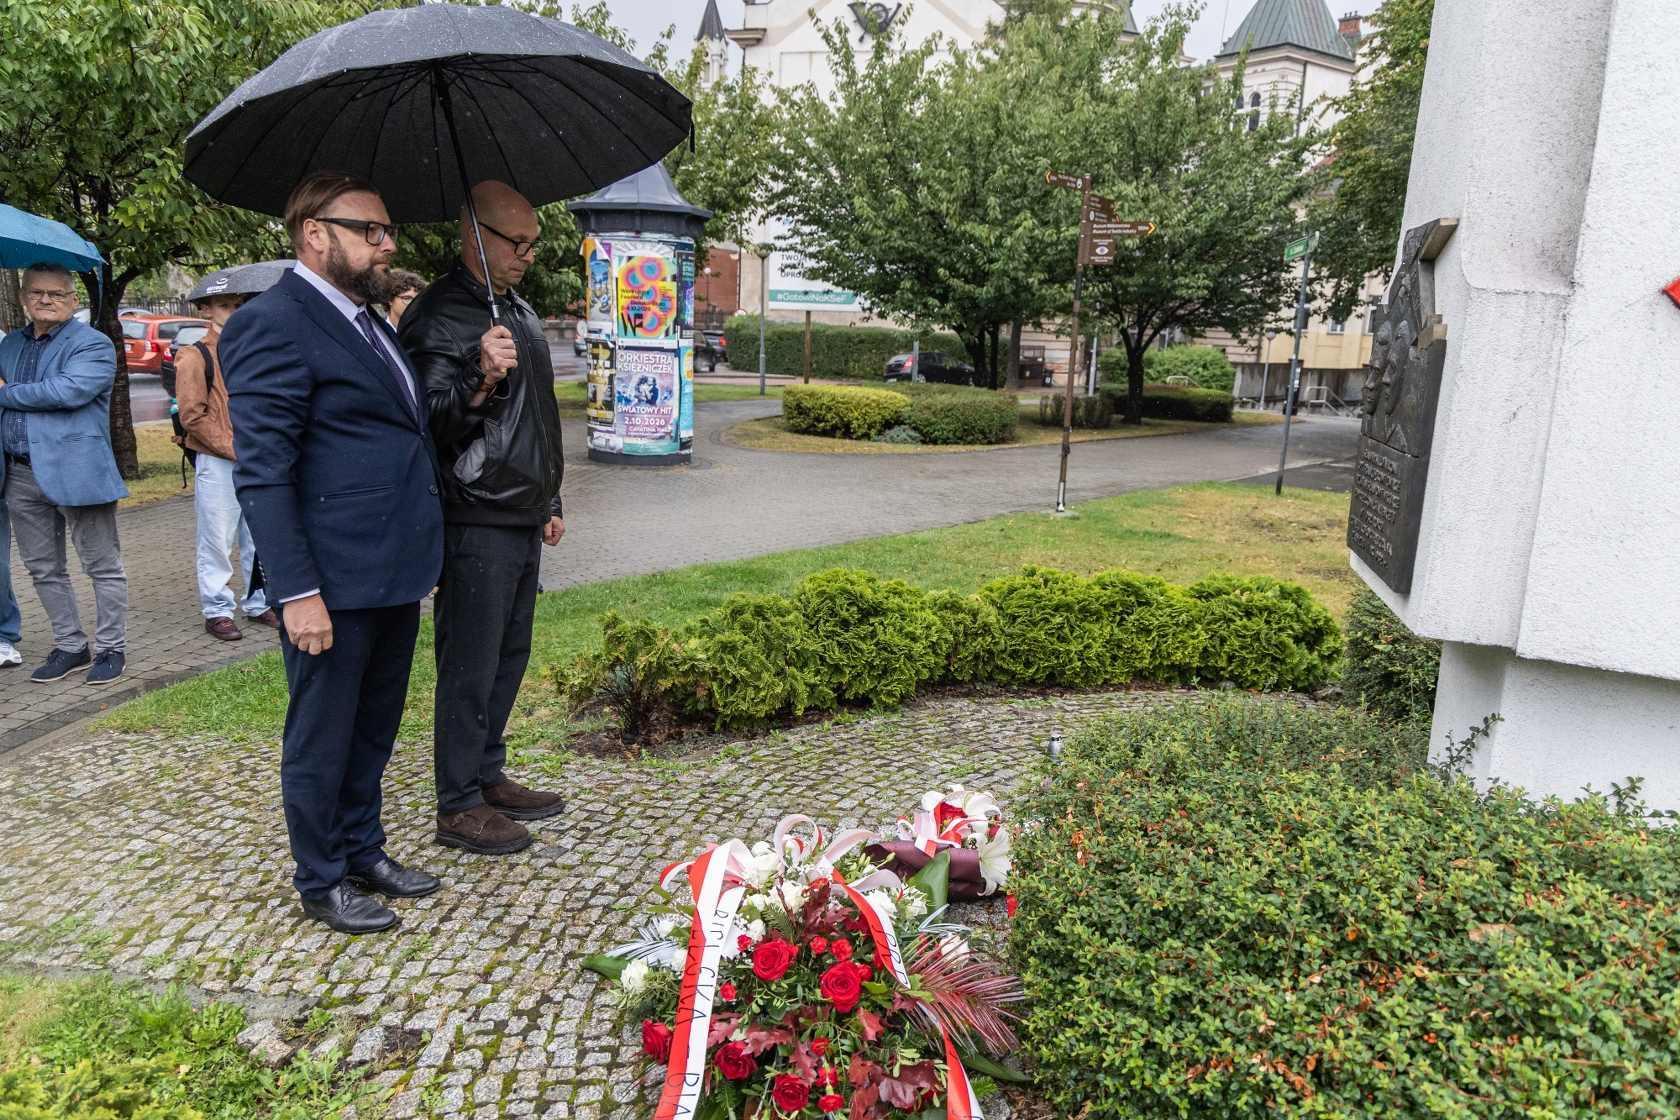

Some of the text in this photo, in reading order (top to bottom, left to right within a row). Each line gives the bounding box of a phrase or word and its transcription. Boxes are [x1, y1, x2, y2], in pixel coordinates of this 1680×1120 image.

[777, 292, 847, 303] #GotowiNaKSeF
[618, 352, 673, 365] ORKIESTRA
[617, 404, 659, 414] ŚWIATOWY
[660, 406, 672, 414] HIT
[624, 416, 666, 426] 2.10.2026
